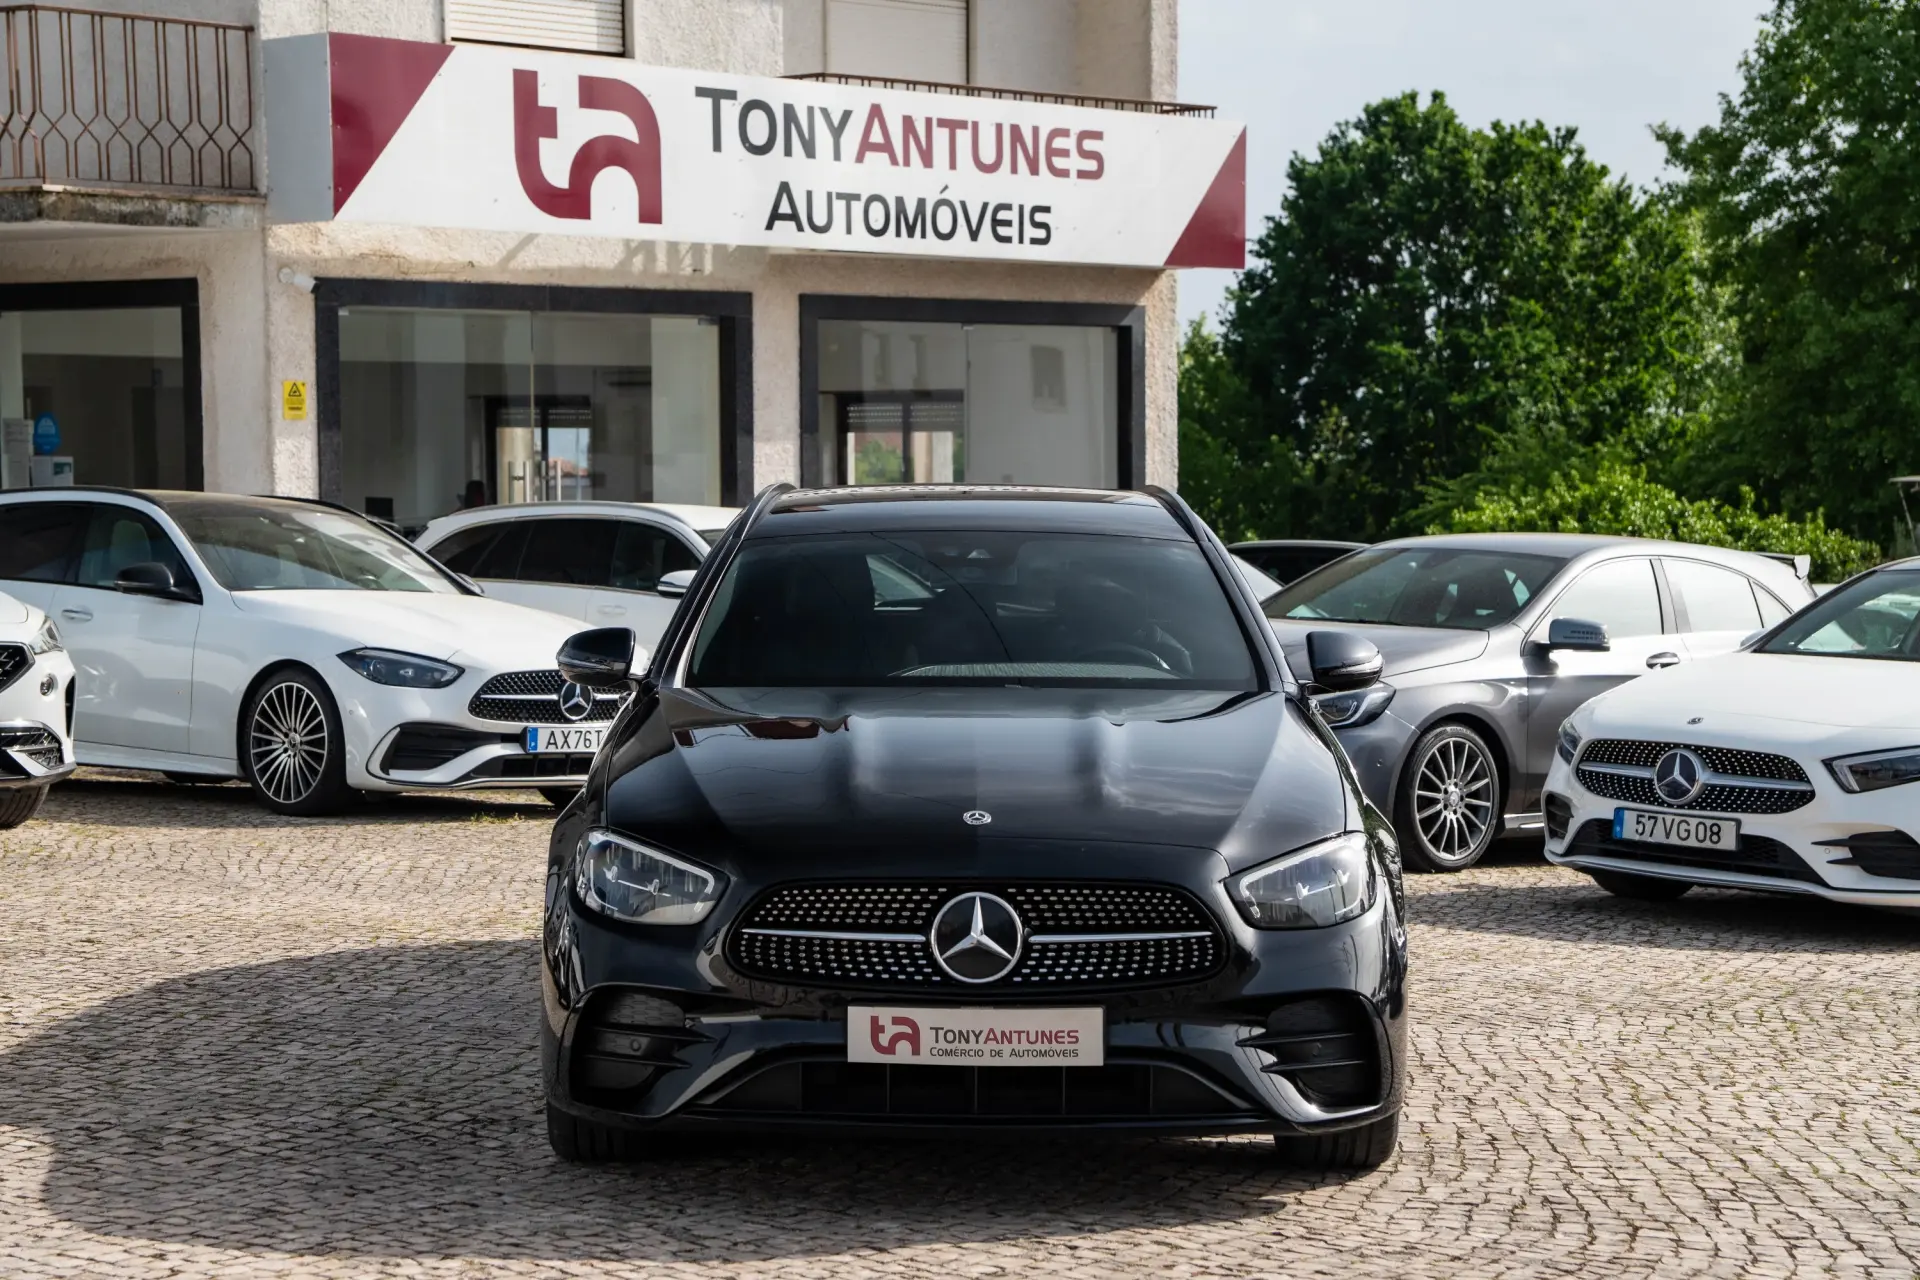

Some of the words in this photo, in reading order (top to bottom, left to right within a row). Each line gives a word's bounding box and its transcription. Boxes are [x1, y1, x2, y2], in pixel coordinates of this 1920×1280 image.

[765, 182, 1052, 246] AUTOMÓVEIS
[545, 730, 602, 749] AX76T
[1635, 814, 1722, 844] 57VG08
[930, 1047, 984, 1058] COMÉRCIO
[990, 1049, 1003, 1058] DE
[1009, 1047, 1079, 1058] AUTOMÓVEIS
